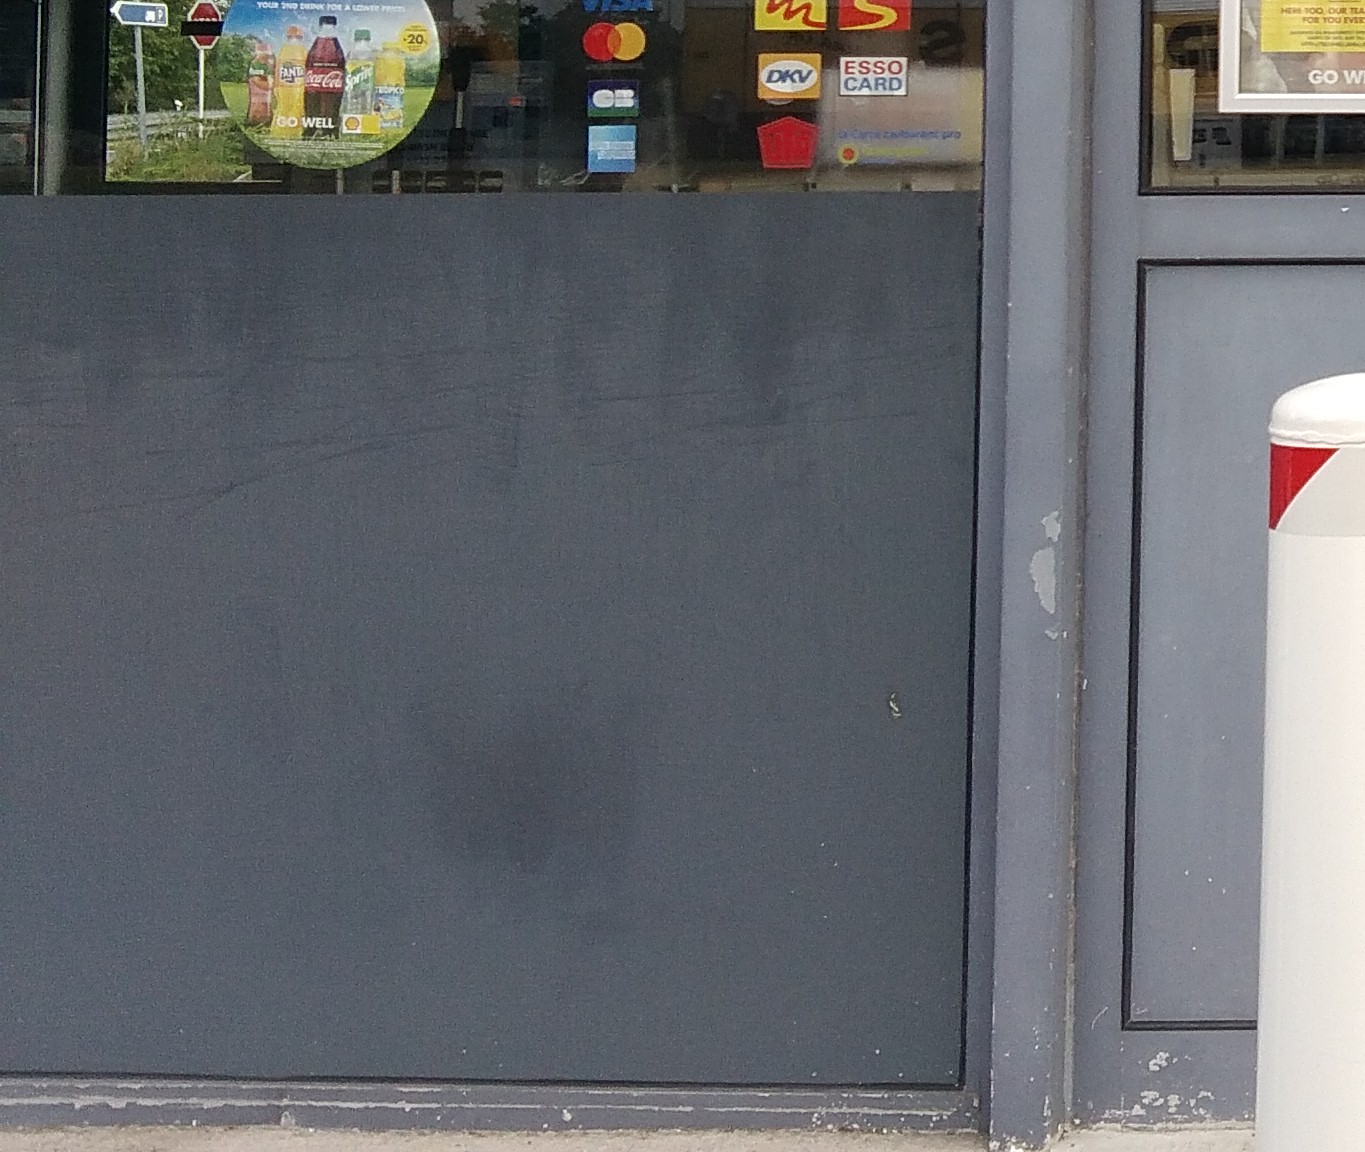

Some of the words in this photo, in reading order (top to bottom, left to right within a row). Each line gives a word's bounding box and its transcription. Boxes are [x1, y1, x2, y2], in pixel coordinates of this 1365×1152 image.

[256, 1, 278, 10] YOUR
[300, 2, 324, 11] DRINK
[327, 3, 342, 11] FOR
[344, 3, 351, 11] A
[1328, 7, 1348, 15] OUR
[1302, 16, 1319, 24] FOR
[1323, 16, 1341, 24] YOU
[844, 60, 903, 75] ESSO
[345, 66, 374, 90] Sprite
[766, 69, 814, 84] DKV
[1308, 69, 1339, 85] GO
[844, 77, 903, 92] CARD
[276, 116, 298, 128] GO
[302, 116, 335, 129] WELL
